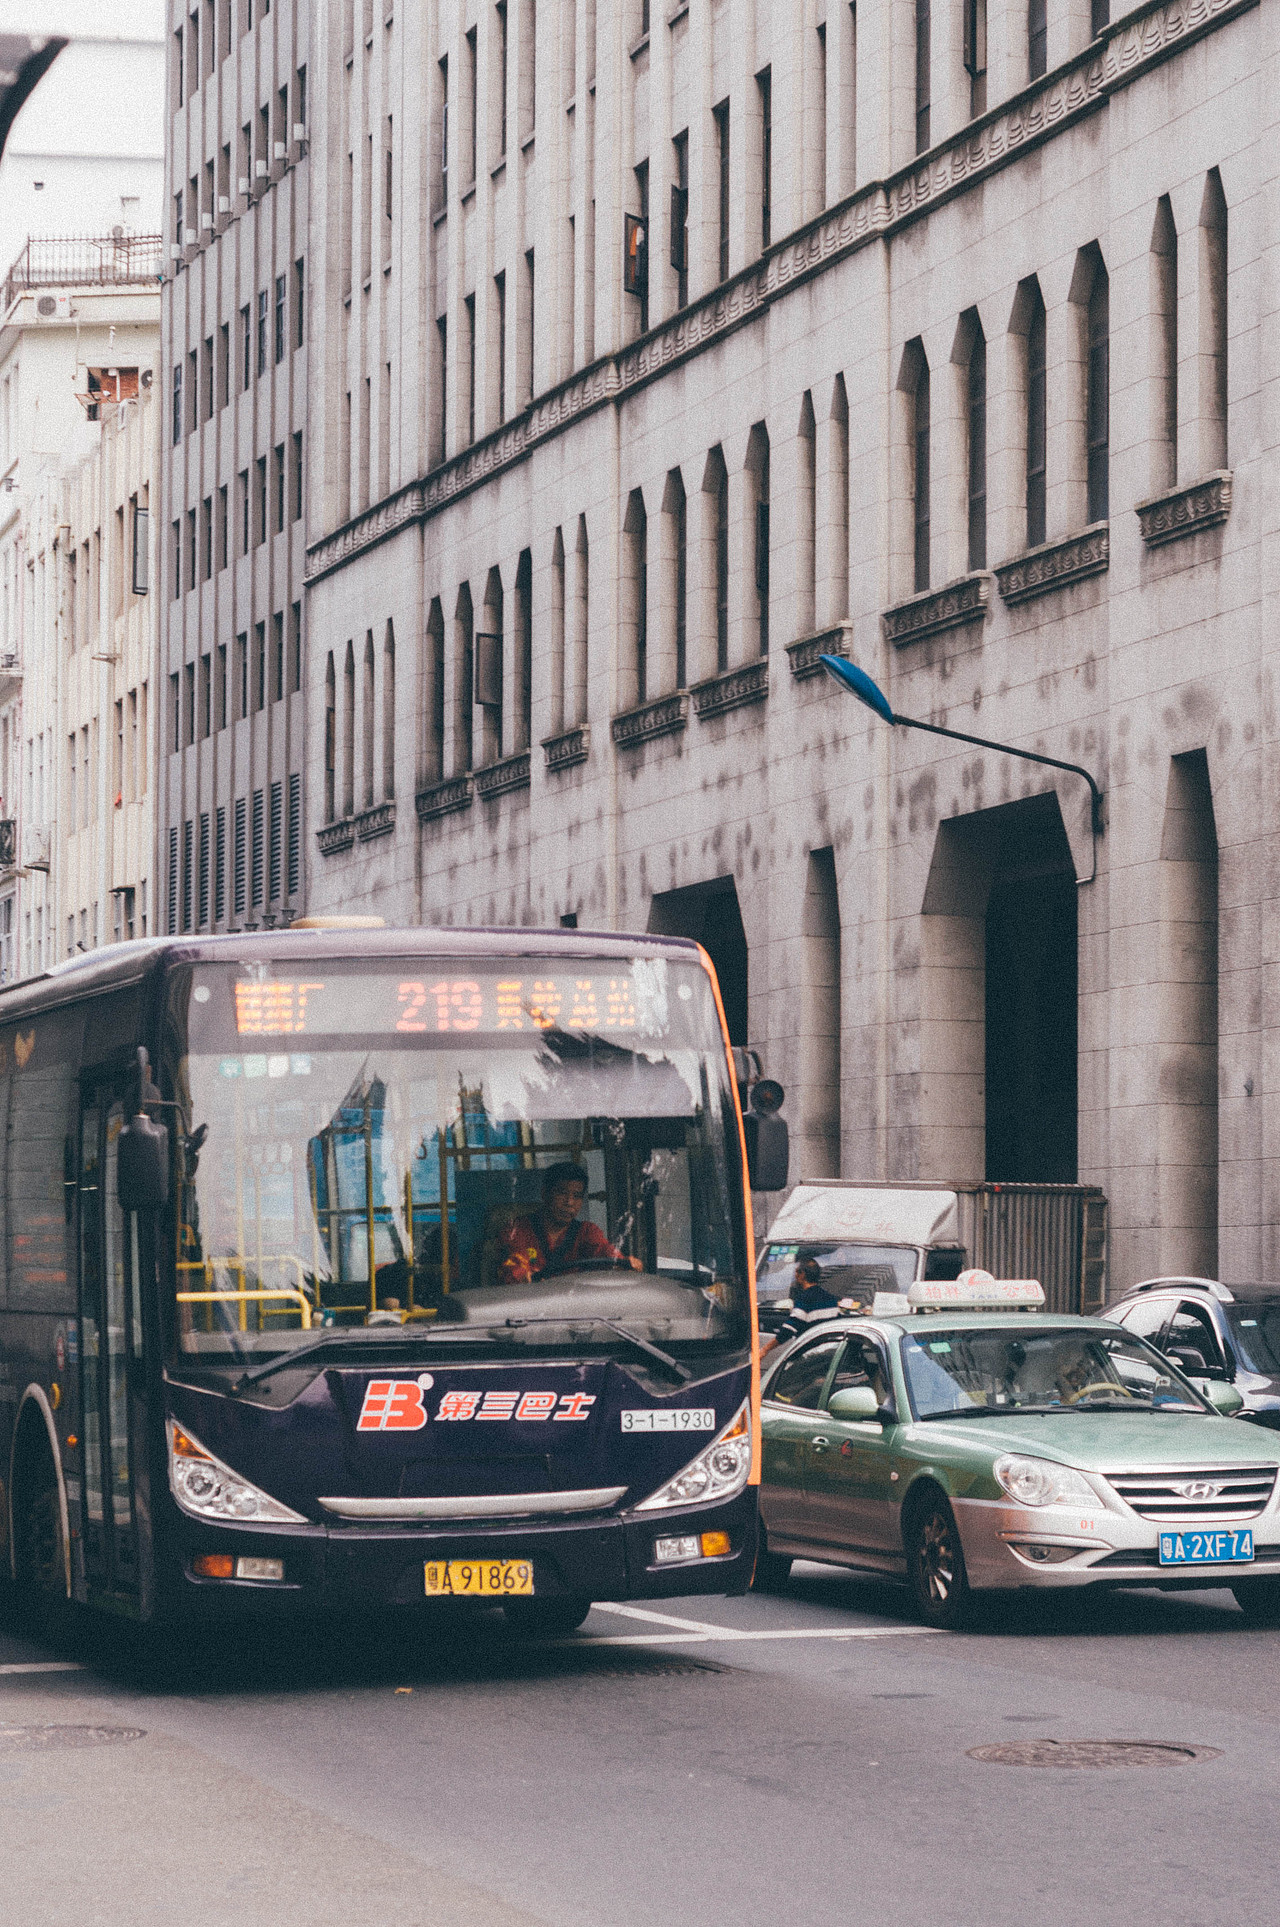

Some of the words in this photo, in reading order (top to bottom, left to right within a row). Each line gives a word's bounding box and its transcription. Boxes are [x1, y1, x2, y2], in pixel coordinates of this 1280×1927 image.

[396, 981, 482, 1031] 219
[1002, 1284, 1040, 1298] 公司
[434, 1391, 597, 1421] 第三巴士
[623, 1411, 713, 1430] 3-1-1930
[1080, 1519, 1094, 1530] 01
